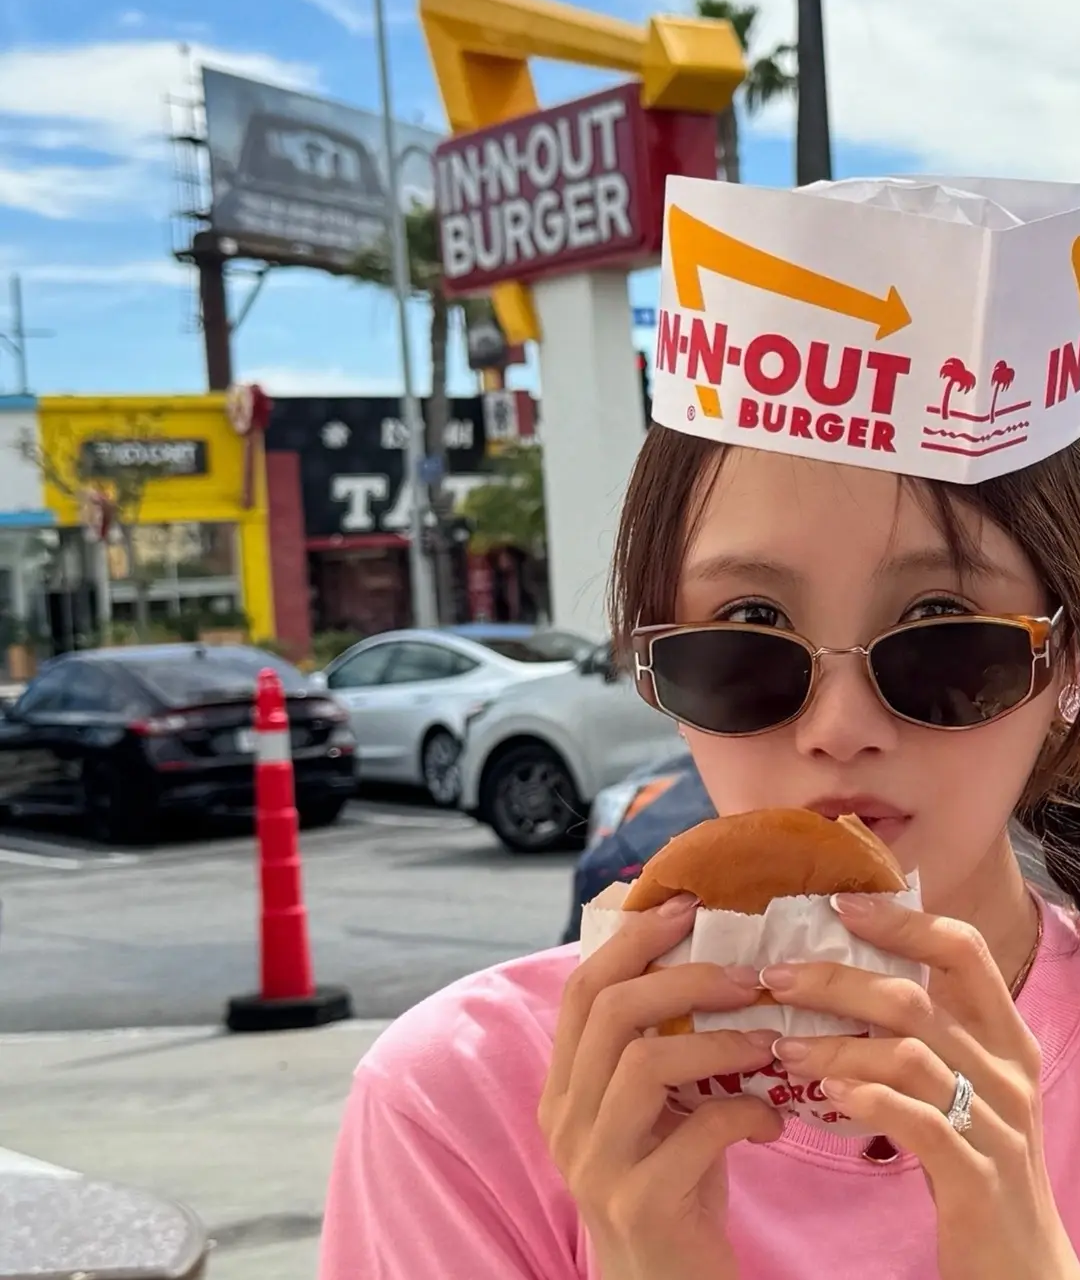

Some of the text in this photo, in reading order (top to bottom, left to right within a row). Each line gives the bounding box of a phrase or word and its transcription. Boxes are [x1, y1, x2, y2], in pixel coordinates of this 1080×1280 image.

[437, 100, 626, 215] IN-N-OUT
[443, 172, 632, 278] BURGER
[656, 309, 912, 415] IN-N-OUT
[738, 397, 897, 453] BURGER
